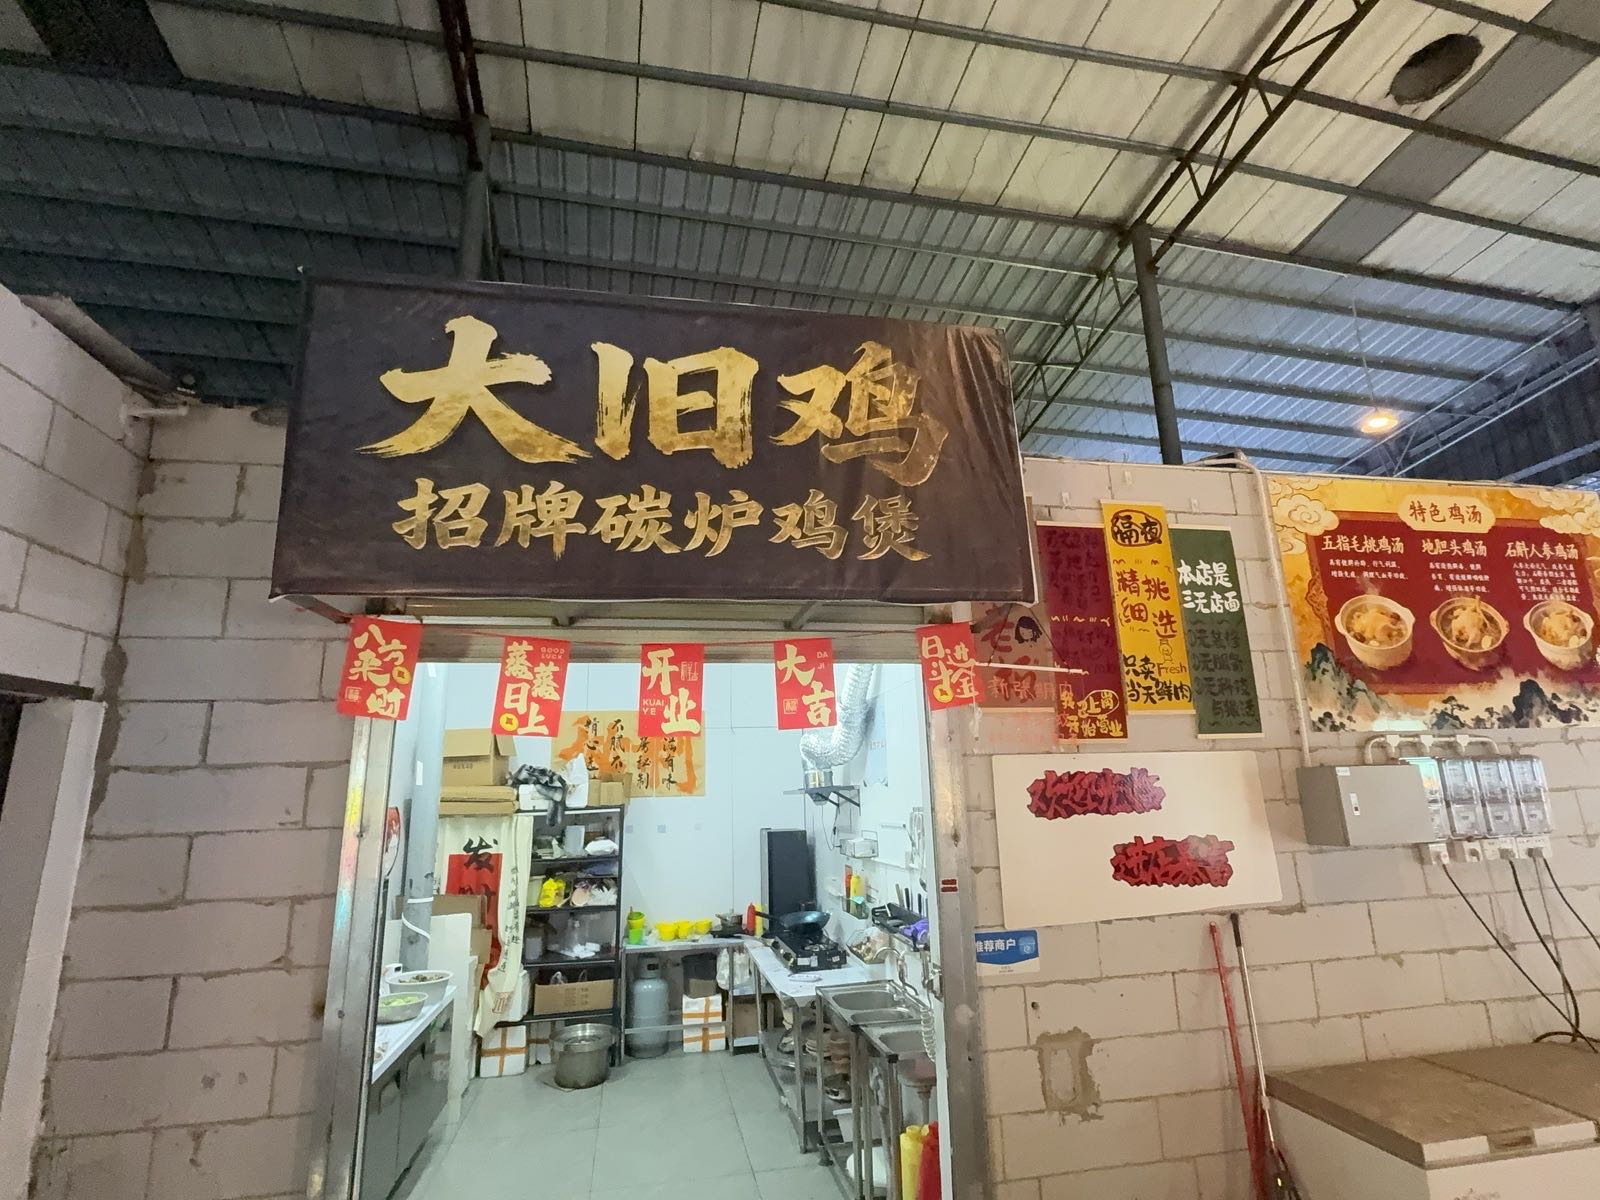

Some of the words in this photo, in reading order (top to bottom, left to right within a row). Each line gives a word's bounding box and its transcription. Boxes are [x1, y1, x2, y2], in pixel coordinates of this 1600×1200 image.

[356, 314, 949, 486] 大旧鸡
[392, 477, 932, 562] 招牌碳炉鸡煲
[1408, 500, 1482, 525] 特色鸡汤
[1321, 534, 1405, 556] 五指毛桃鸡汤
[1421, 538, 1488, 558] 地胆头鸡汤
[1504, 541, 1580, 561] 石斛人参鸡汤
[1116, 568, 1171, 601] 精挑
[1177, 559, 1233, 588] 本店是
[1181, 589, 1240, 614] 三无店面
[1121, 597, 1177, 638] 细选
[816, 651, 829, 659] DA
[1122, 654, 1157, 681] 只卖
[1157, 662, 1187, 677] Fresh
[503, 640, 561, 736] 蒸蒸日上
[641, 647, 701, 735] 开业
[776, 643, 835, 727] 大吉
[1126, 678, 1192, 705] 当天鲜肉
[642, 699, 665, 707] KUAI
[642, 707, 657, 716] YE
